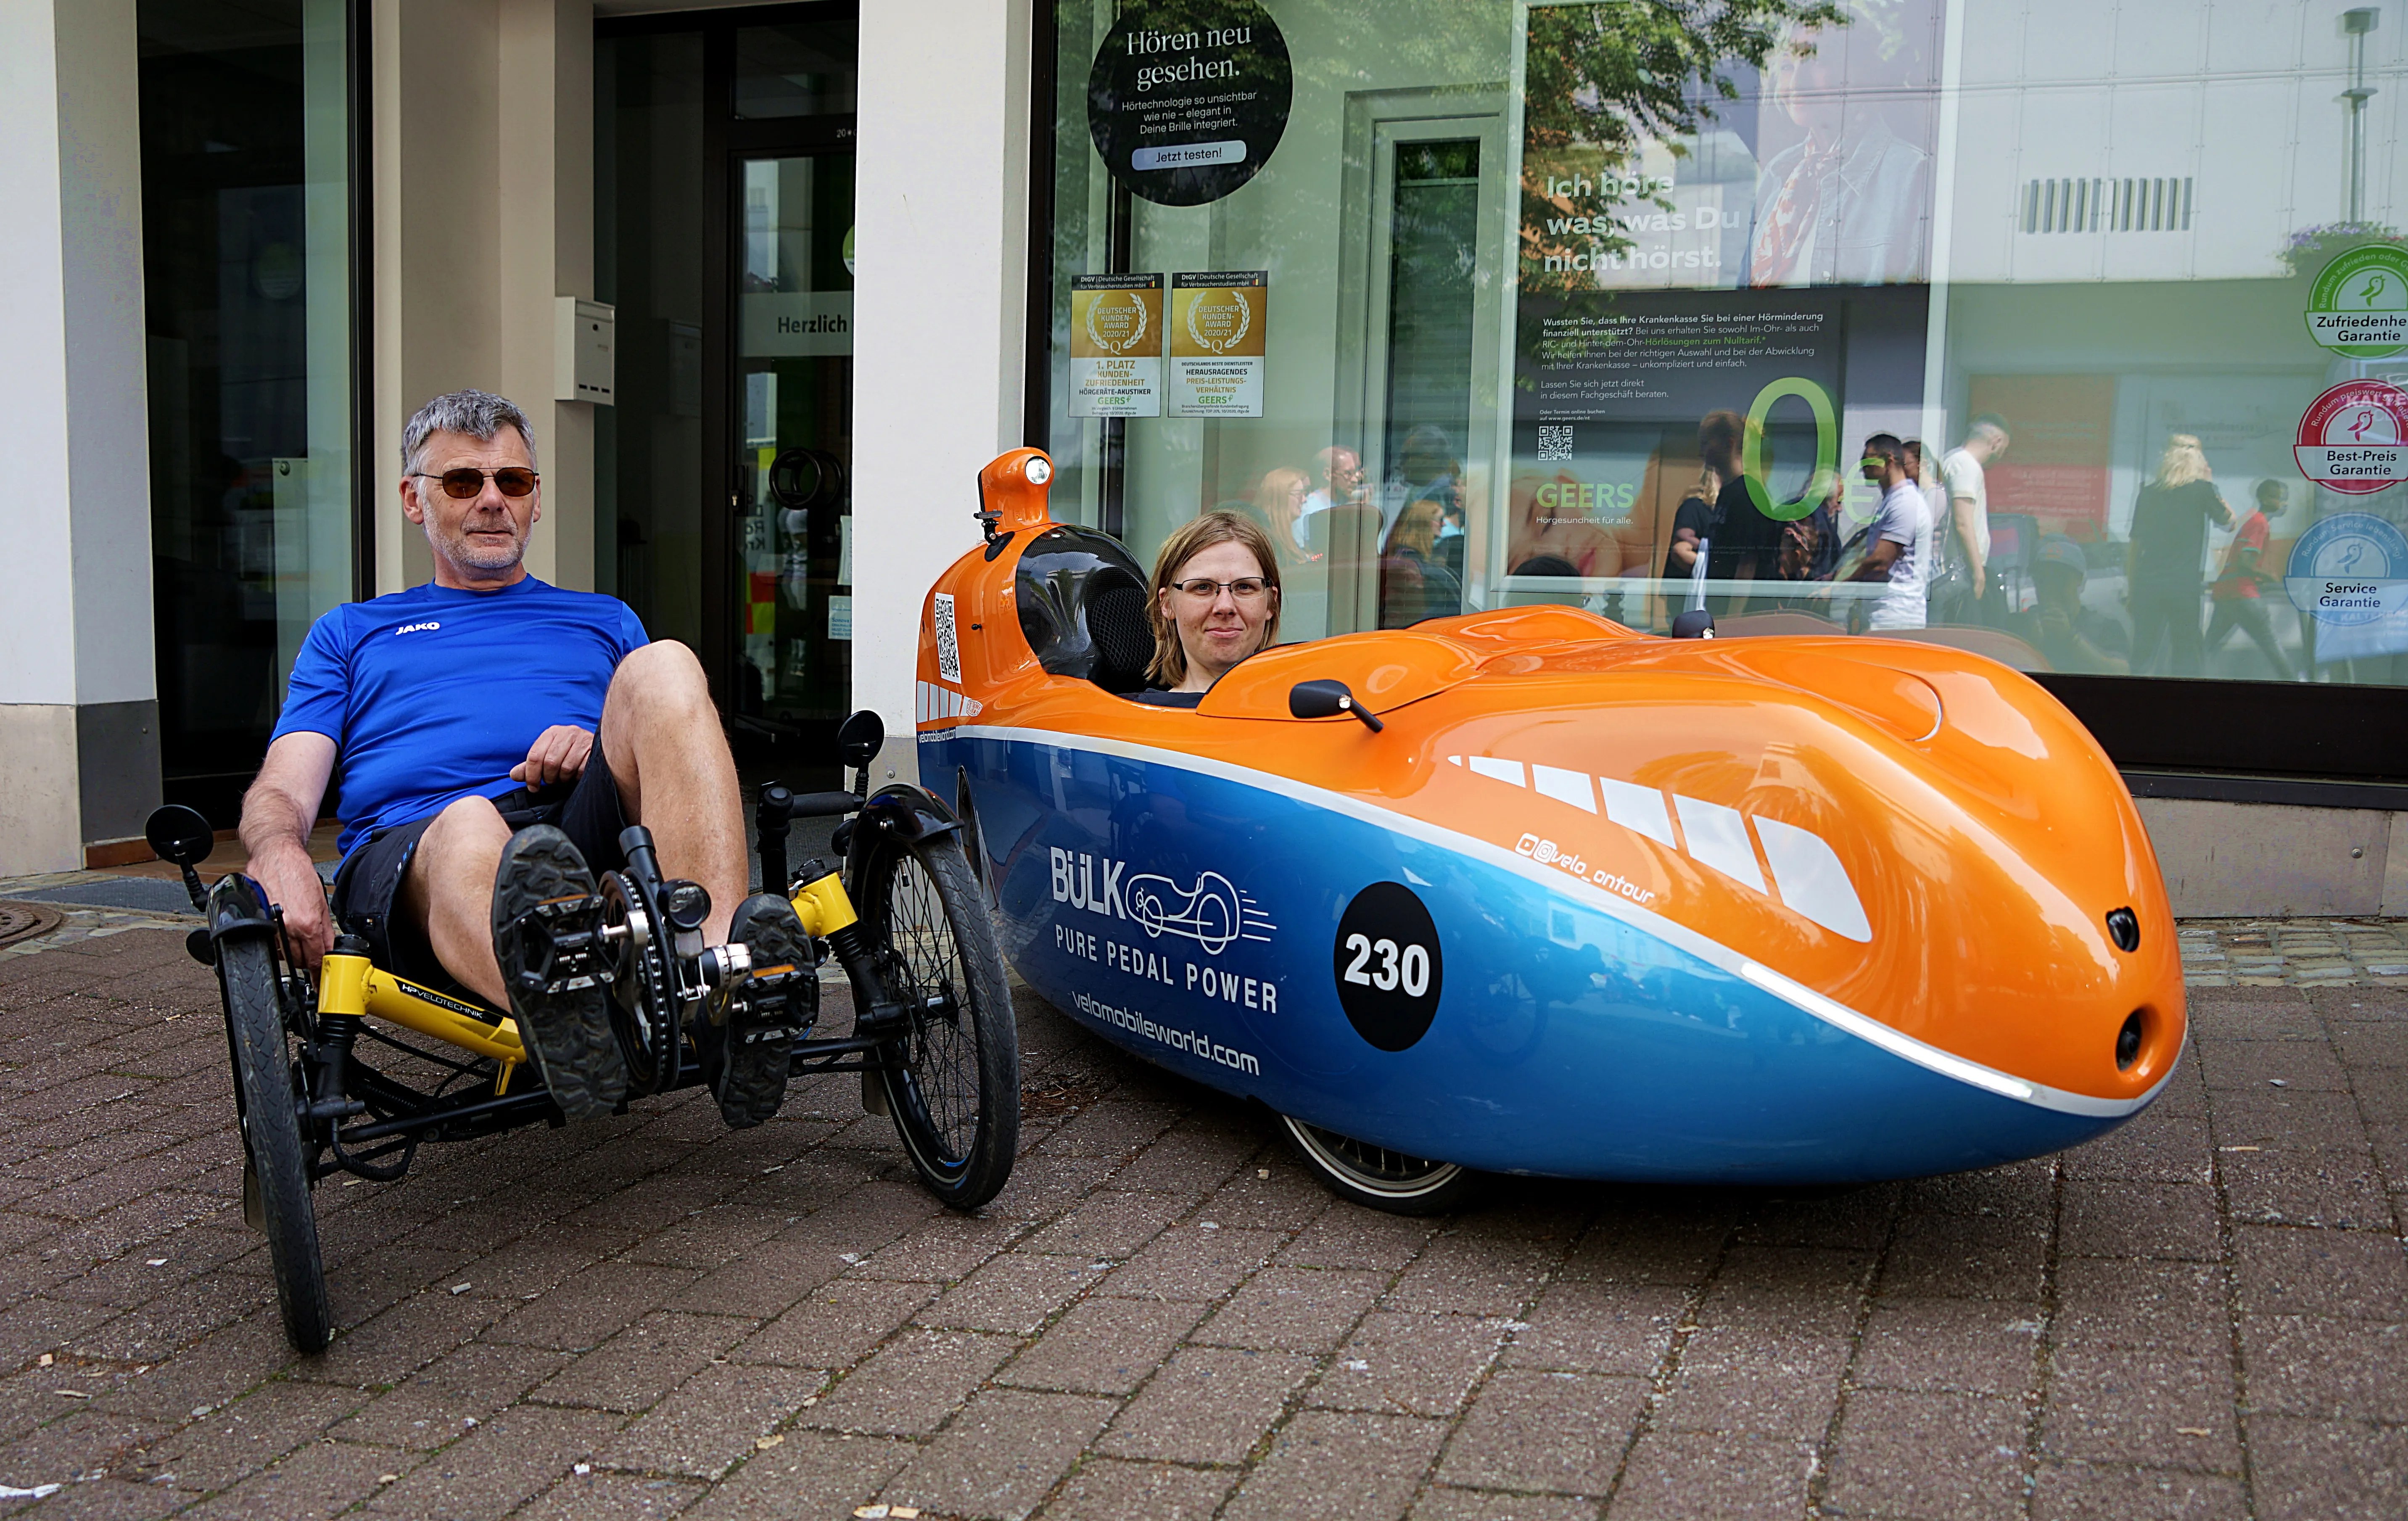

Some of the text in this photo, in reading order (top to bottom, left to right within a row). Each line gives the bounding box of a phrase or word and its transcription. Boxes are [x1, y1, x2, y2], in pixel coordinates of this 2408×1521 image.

[1127, 26, 1252, 55] Hören neu
[1137, 55, 1240, 92] gesehen.
[1122, 96, 1192, 111] Hörtechnologie
[1207, 91, 1257, 103] unsichtbar
[1143, 105, 1231, 121] wie nie elegant in
[1140, 118, 1238, 135] Deine Brille integriert.
[1156, 147, 1222, 163] Jetzt testen!
[1547, 170, 1674, 198] Ich höre
[1546, 206, 1740, 238] was, was Du
[1544, 245, 1722, 272] nicht hörst.
[2318, 275, 2337, 309] Rundum
[2337, 253, 2376, 275] zufrieden
[2379, 253, 2400, 263] oder
[778, 314, 847, 334] Herzlich
[1579, 317, 1595, 326] Sie,
[1598, 316, 1617, 325] dass
[1620, 316, 1636, 324] Ihre
[1639, 315, 1698, 324] Krankenkasse
[1700, 314, 1714, 322] Sie
[1716, 314, 1731, 322] bei
[1758, 312, 1823, 325] Hörminderung
[2317, 315, 2408, 327] Zufriedenhe
[1542, 328, 1579, 337] finanziell
[1581, 327, 1633, 337] unterstützt?
[1667, 326, 1701, 334] erhalten
[1703, 325, 1716, 334] Sie
[1718, 325, 1747, 333] sowohl
[1750, 325, 1782, 333] Im-Ohr-
[2337, 329, 2401, 342] Garantie
[1542, 340, 1559, 349] RIC-
[1579, 337, 1700, 347] Hinter-dem-Ohr-Hörlösungen
[1557, 350, 1582, 359] helfen
[1584, 349, 1606, 358] Ihnen
[1608, 349, 1621, 358] bei
[1640, 349, 1675, 359] richtigen
[1677, 348, 1712, 356] Auswahl
[1714, 347, 1731, 356] und
[1733, 347, 1746, 356] bei
[1748, 347, 1763, 355] der
[1765, 346, 1814, 357] Abwicklung
[1096, 360, 1135, 370] 1. PLATZ
[1556, 362, 1574, 370] Ihrer
[1576, 361, 1630, 370] Krankenkasse
[1640, 359, 1694, 370] unkompliziert
[1697, 359, 1713, 367] und
[1715, 358, 1747, 367] einfach.
[1570, 380, 1582, 388] Sie
[1584, 379, 1599, 388] sich
[1600, 380, 1619, 389] jetzt
[1621, 378, 1644, 387] direkt
[1098, 396, 1125, 405] GEERS
[1198, 396, 1227, 404] GEERS
[1550, 391, 1578, 399] diesem
[1581, 389, 1633, 400] Fachgeschäft
[1635, 390, 1669, 398] beraten.
[2311, 397, 2339, 427] Rundum
[2340, 388, 2382, 401] preiswert
[1742, 377, 1837, 522] 0
[2326, 450, 2397, 461] Best-Preis
[2330, 464, 2392, 475] Garantie
[1536, 483, 1634, 508] GEERS
[1536, 515, 1600, 526] Hörgesundheit
[1602, 516, 1615, 524] für
[2301, 529, 2330, 557] Rundum
[2331, 521, 2363, 531] Service
[2325, 582, 2377, 594] Service
[2319, 596, 2381, 608] Garantie
[395, 622, 440, 635] JAKO
[918, 728, 956, 744] velomobileworld.com
[1051, 846, 1126, 919] BÜLK
[1056, 924, 1276, 1014] PURE PEDAL POWER
[1344, 933, 1429, 997] 230
[401, 984, 483, 1019] HPVELOTECHNIK
[1072, 991, 1259, 1076] velomobileworld.com
